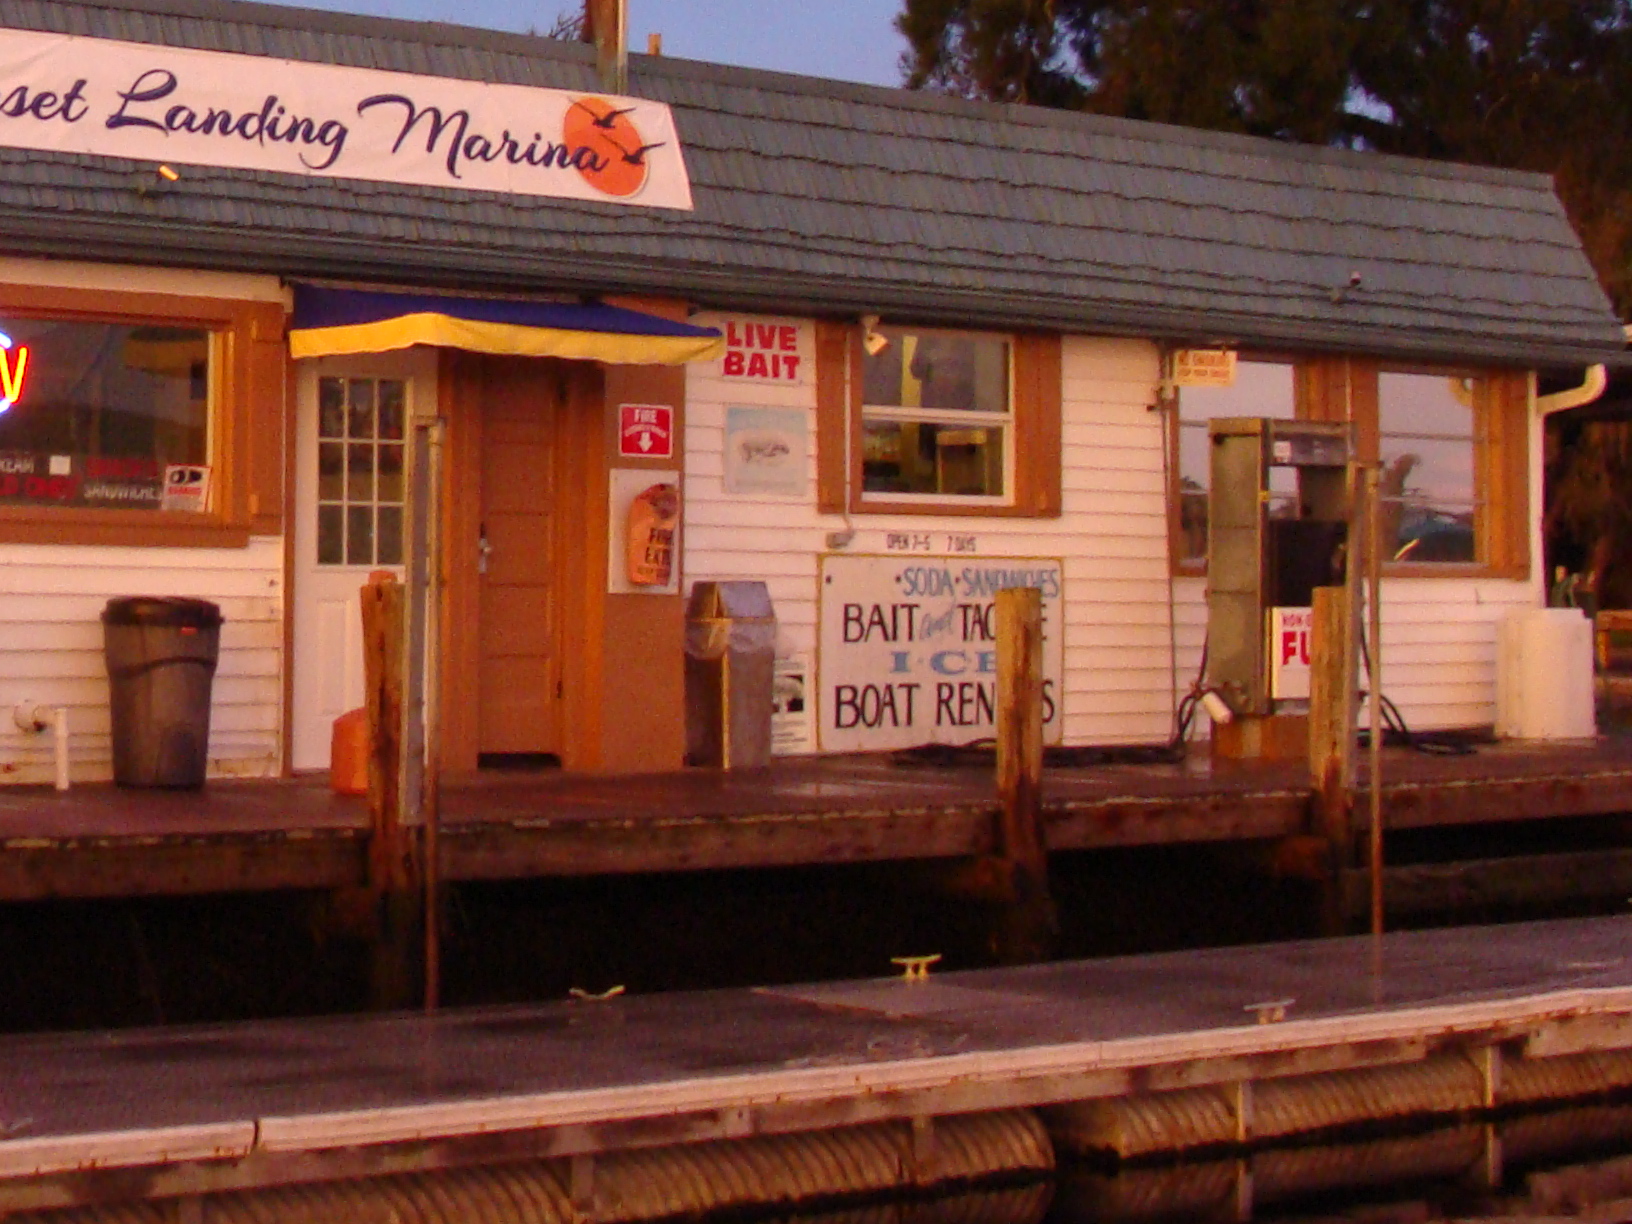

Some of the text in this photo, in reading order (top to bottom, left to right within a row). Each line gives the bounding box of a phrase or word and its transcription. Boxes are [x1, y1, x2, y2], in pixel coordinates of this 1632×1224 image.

[105, 68, 349, 170] Landing
[357, 94, 610, 179] Marina
[726, 321, 797, 352] LIVE
[723, 350, 801, 380] BAIT
[903, 567, 955, 598] SODA
[842, 603, 921, 643] BAIT
[834, 679, 1055, 729] BOAT RENS
